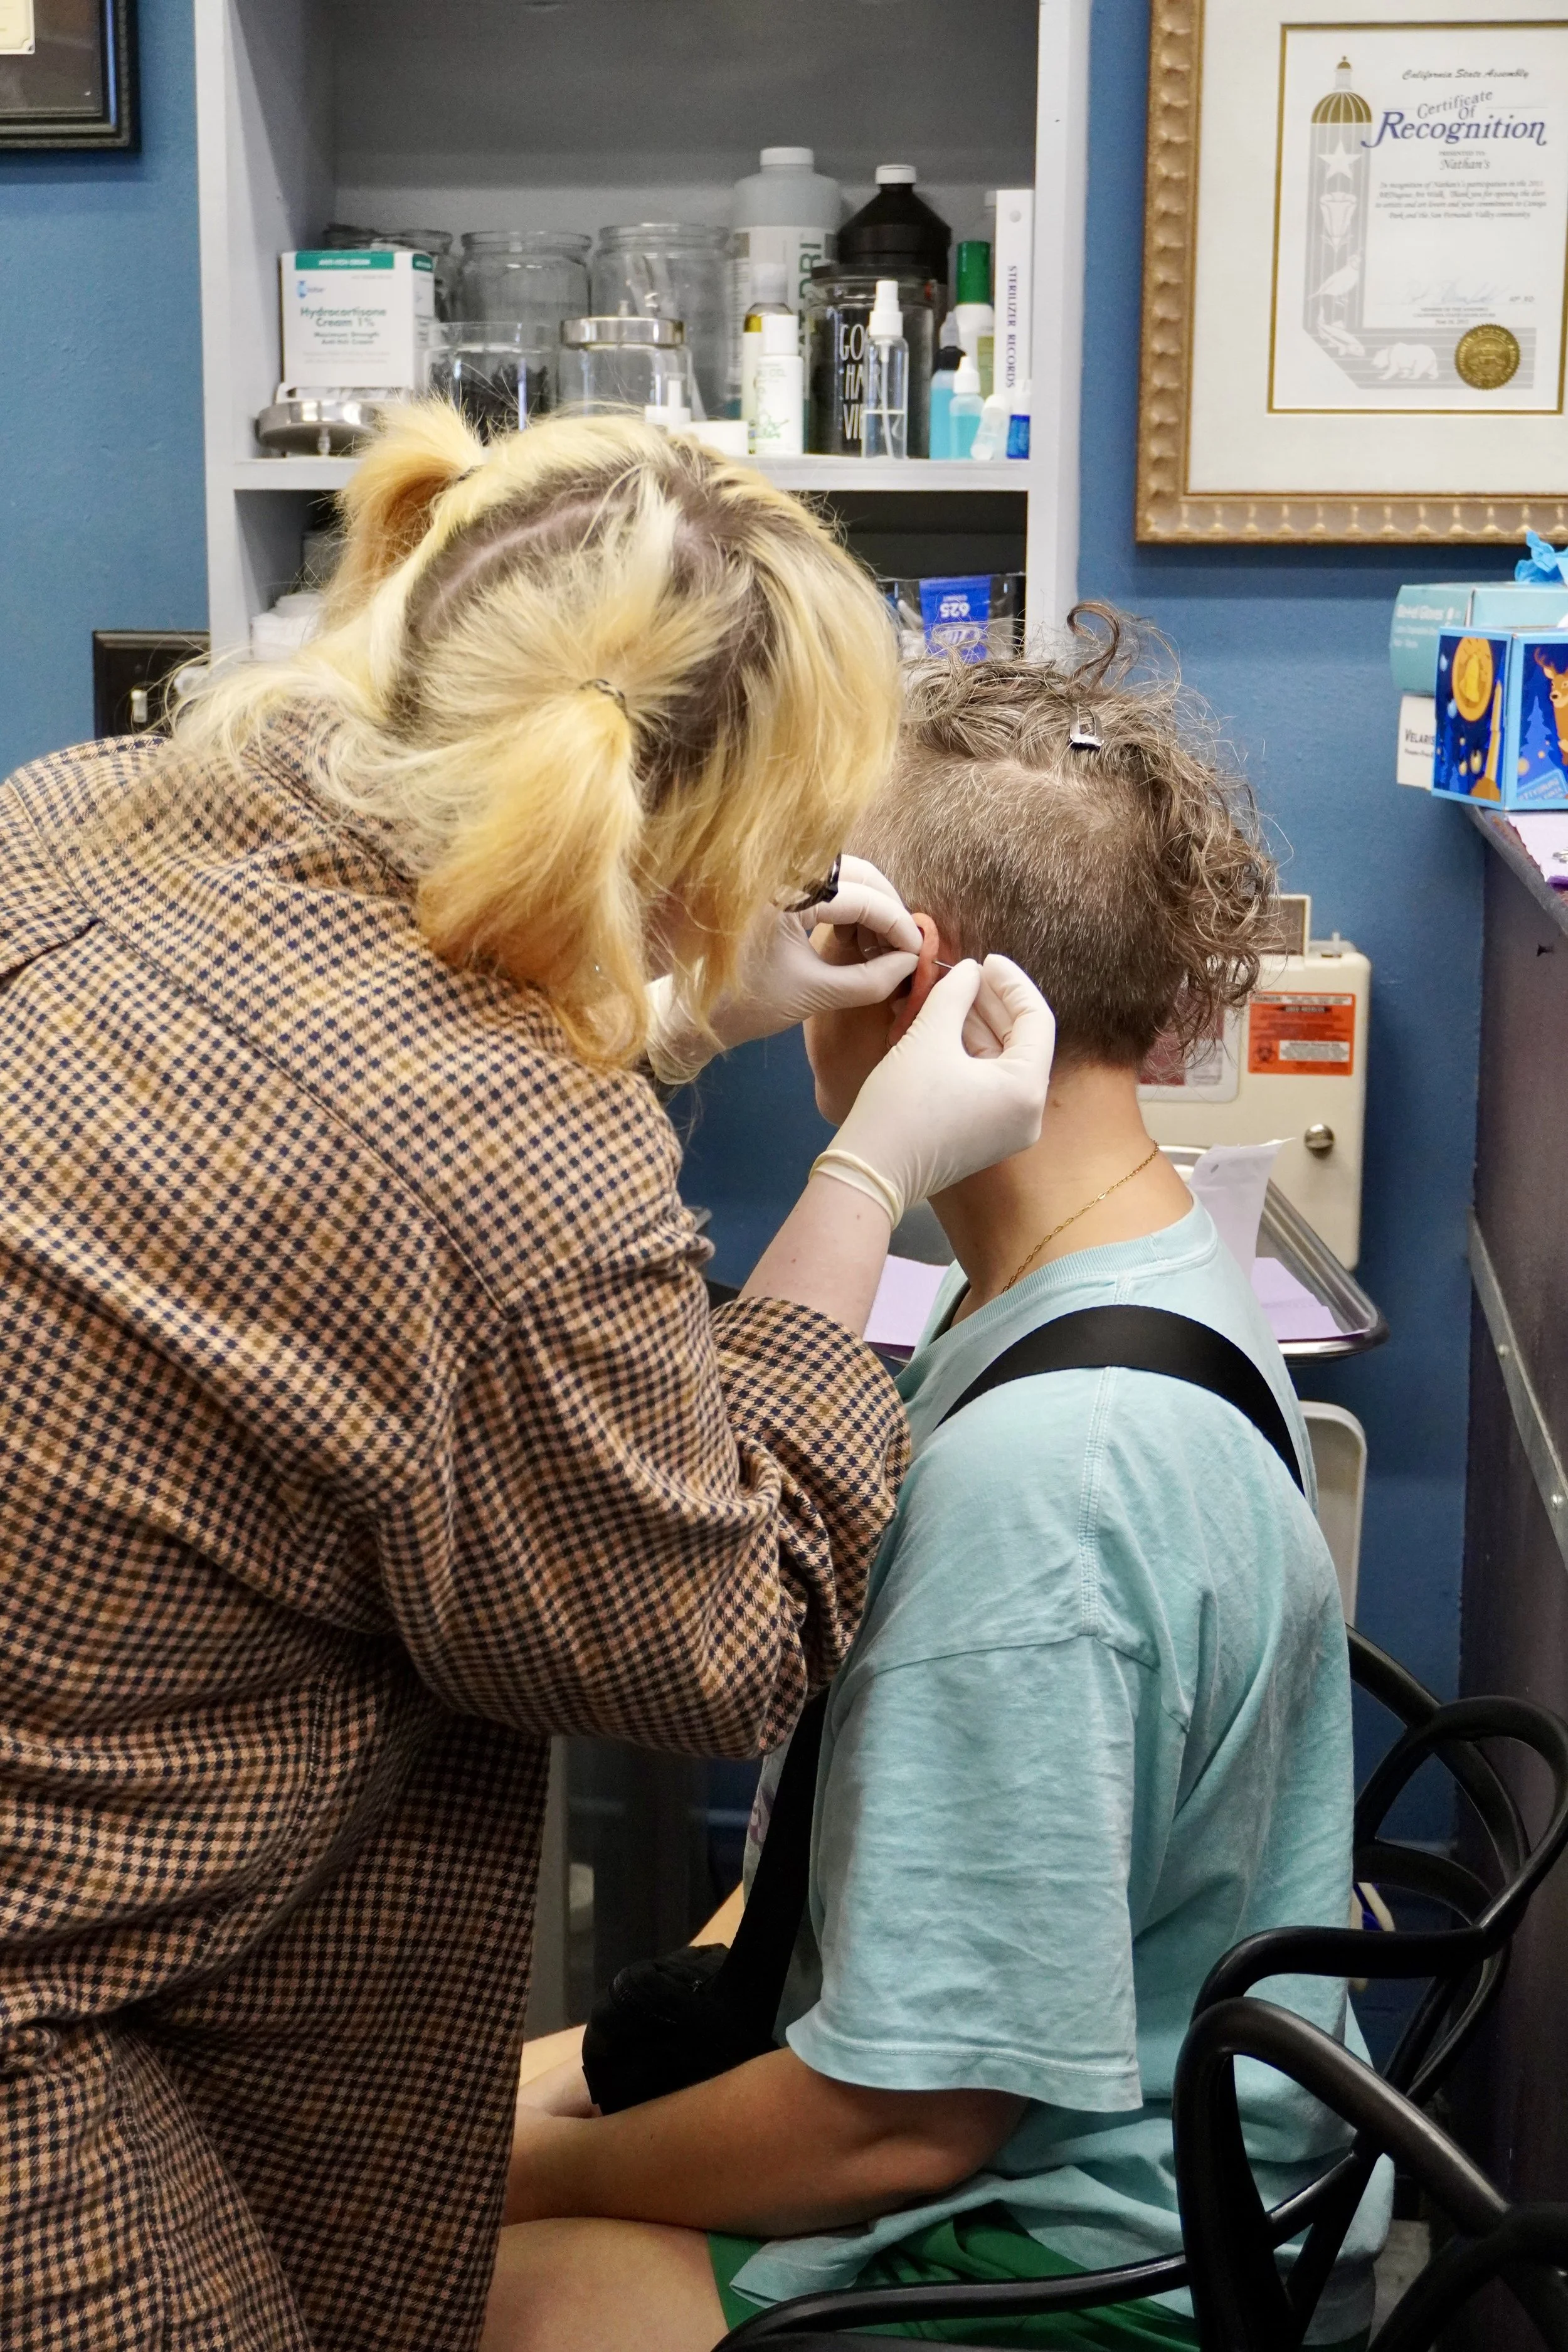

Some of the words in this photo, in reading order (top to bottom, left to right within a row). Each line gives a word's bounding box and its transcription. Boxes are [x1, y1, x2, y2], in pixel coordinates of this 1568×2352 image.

[1401, 69, 1453, 80] California
[1454, 68, 1481, 78] State
[1484, 68, 1530, 79] Assembly
[1416, 91, 1493, 120] Certificate
[1458, 105, 1477, 120] Of
[1360, 111, 1547, 148] Recognition
[1439, 157, 1491, 170] Nathan's
[1007, 265, 1017, 327] STERILIZER
[300, 306, 386, 319] Hydrocortisone
[315, 317, 352, 327] Cream
[1006, 334, 1017, 388] RECORDS
[940, 601, 971, 618] 625
